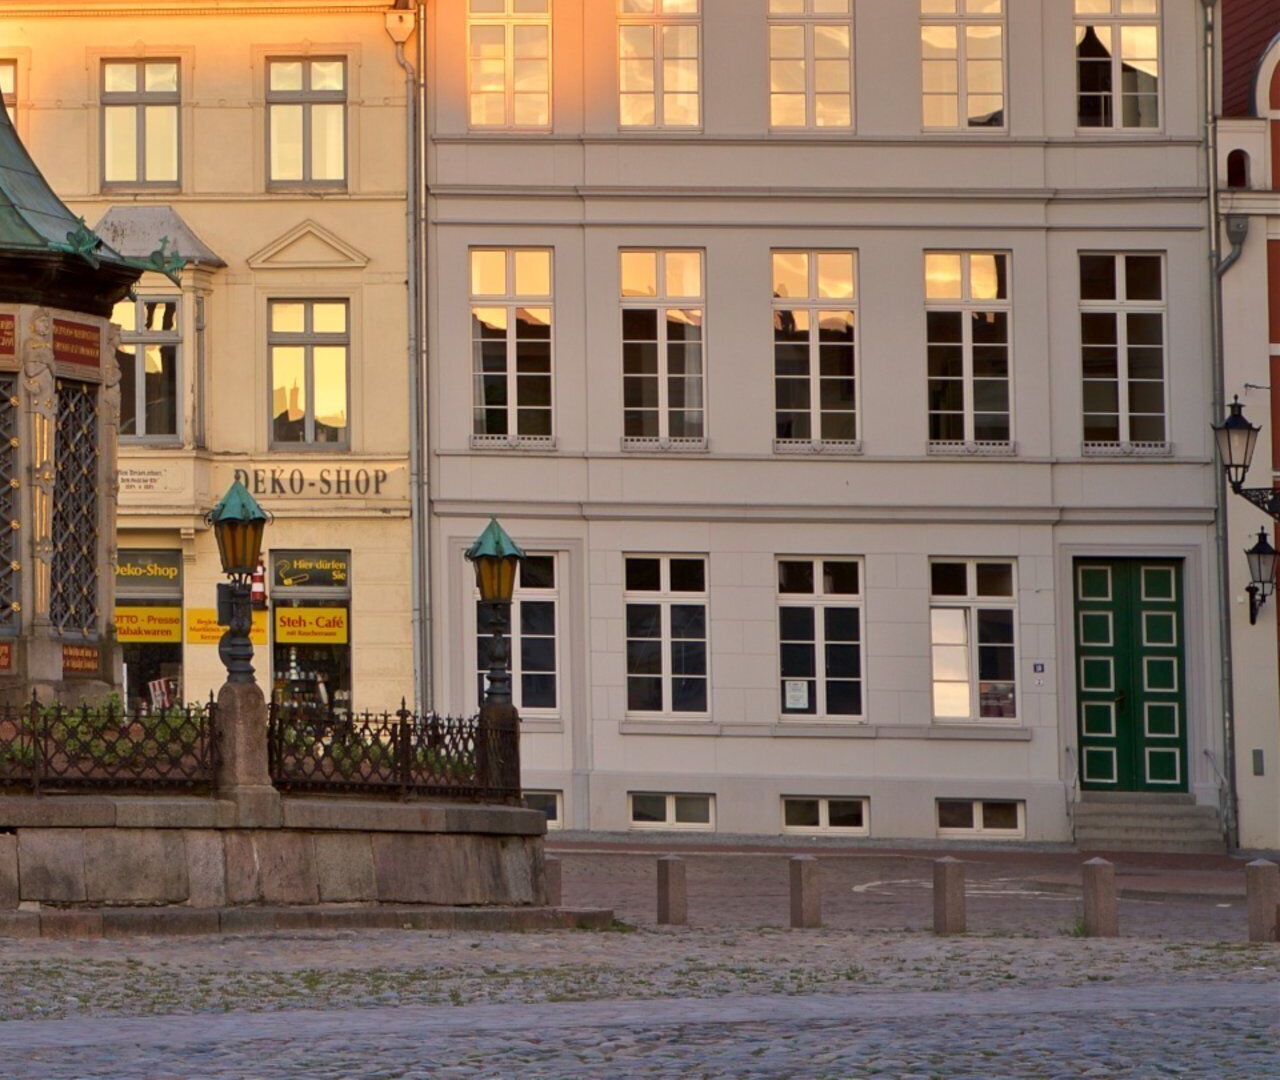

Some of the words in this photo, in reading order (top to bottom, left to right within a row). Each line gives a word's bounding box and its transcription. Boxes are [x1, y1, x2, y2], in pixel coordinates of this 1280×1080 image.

[234, 469, 387, 494] DEKO-SHOP
[293, 560, 313, 569] Hier
[315, 560, 346, 569] dürfen
[332, 570, 346, 580] Sie
[148, 615, 179, 624] Presse
[280, 615, 306, 627] Steh
[315, 615, 343, 628] Café
